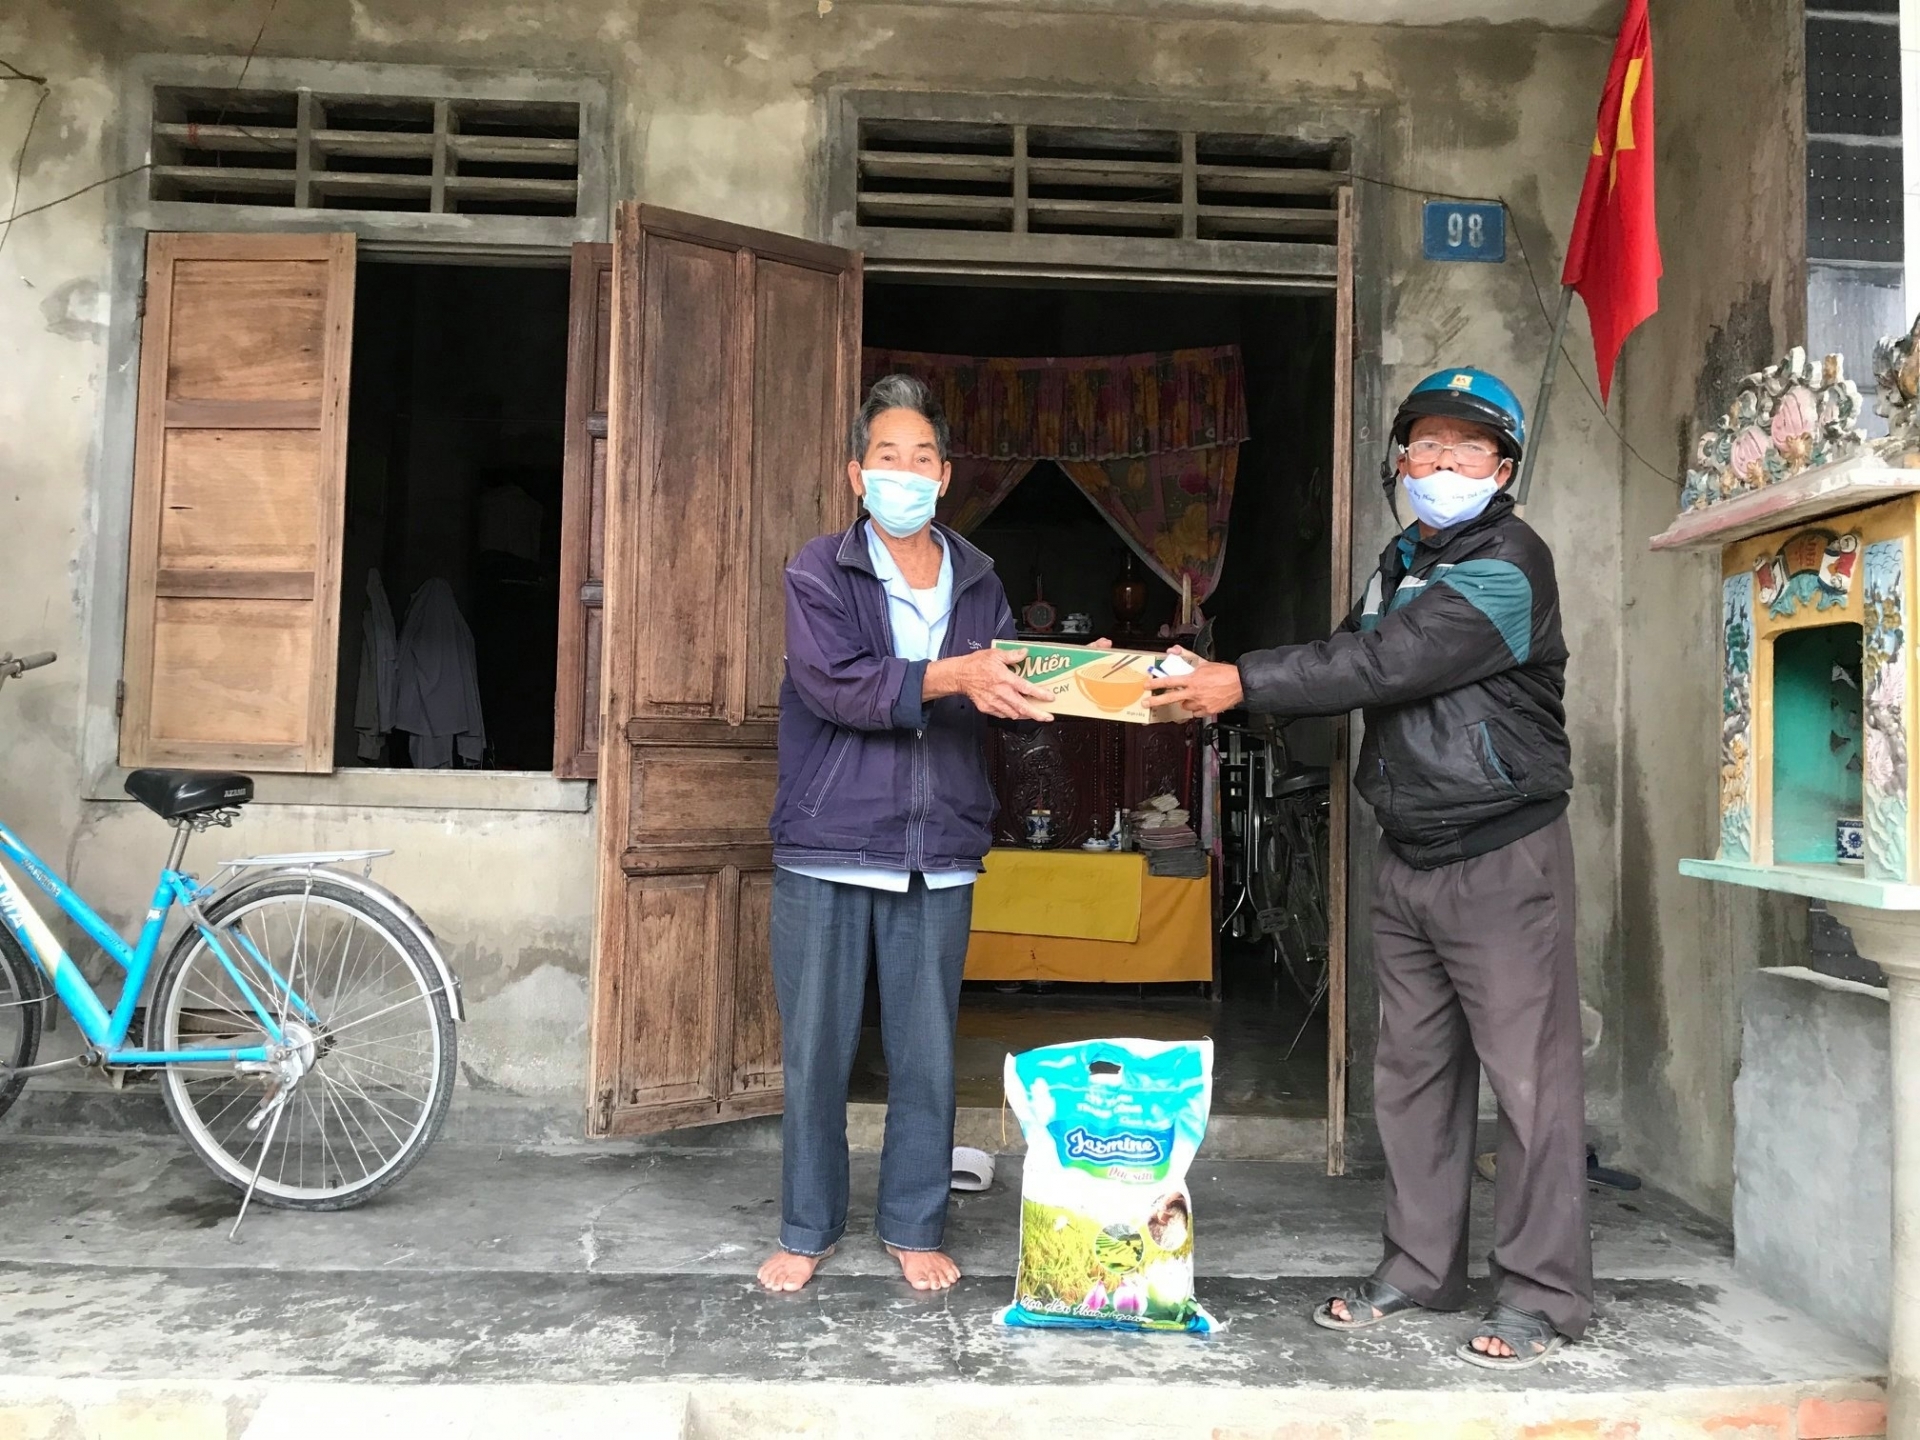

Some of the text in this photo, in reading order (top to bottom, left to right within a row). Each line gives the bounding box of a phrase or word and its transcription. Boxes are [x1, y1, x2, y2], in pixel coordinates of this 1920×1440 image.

[1448, 213, 1484, 248] 98
[1052, 683, 1070, 695] CAY
[1070, 1129, 1155, 1155] Jasmine
